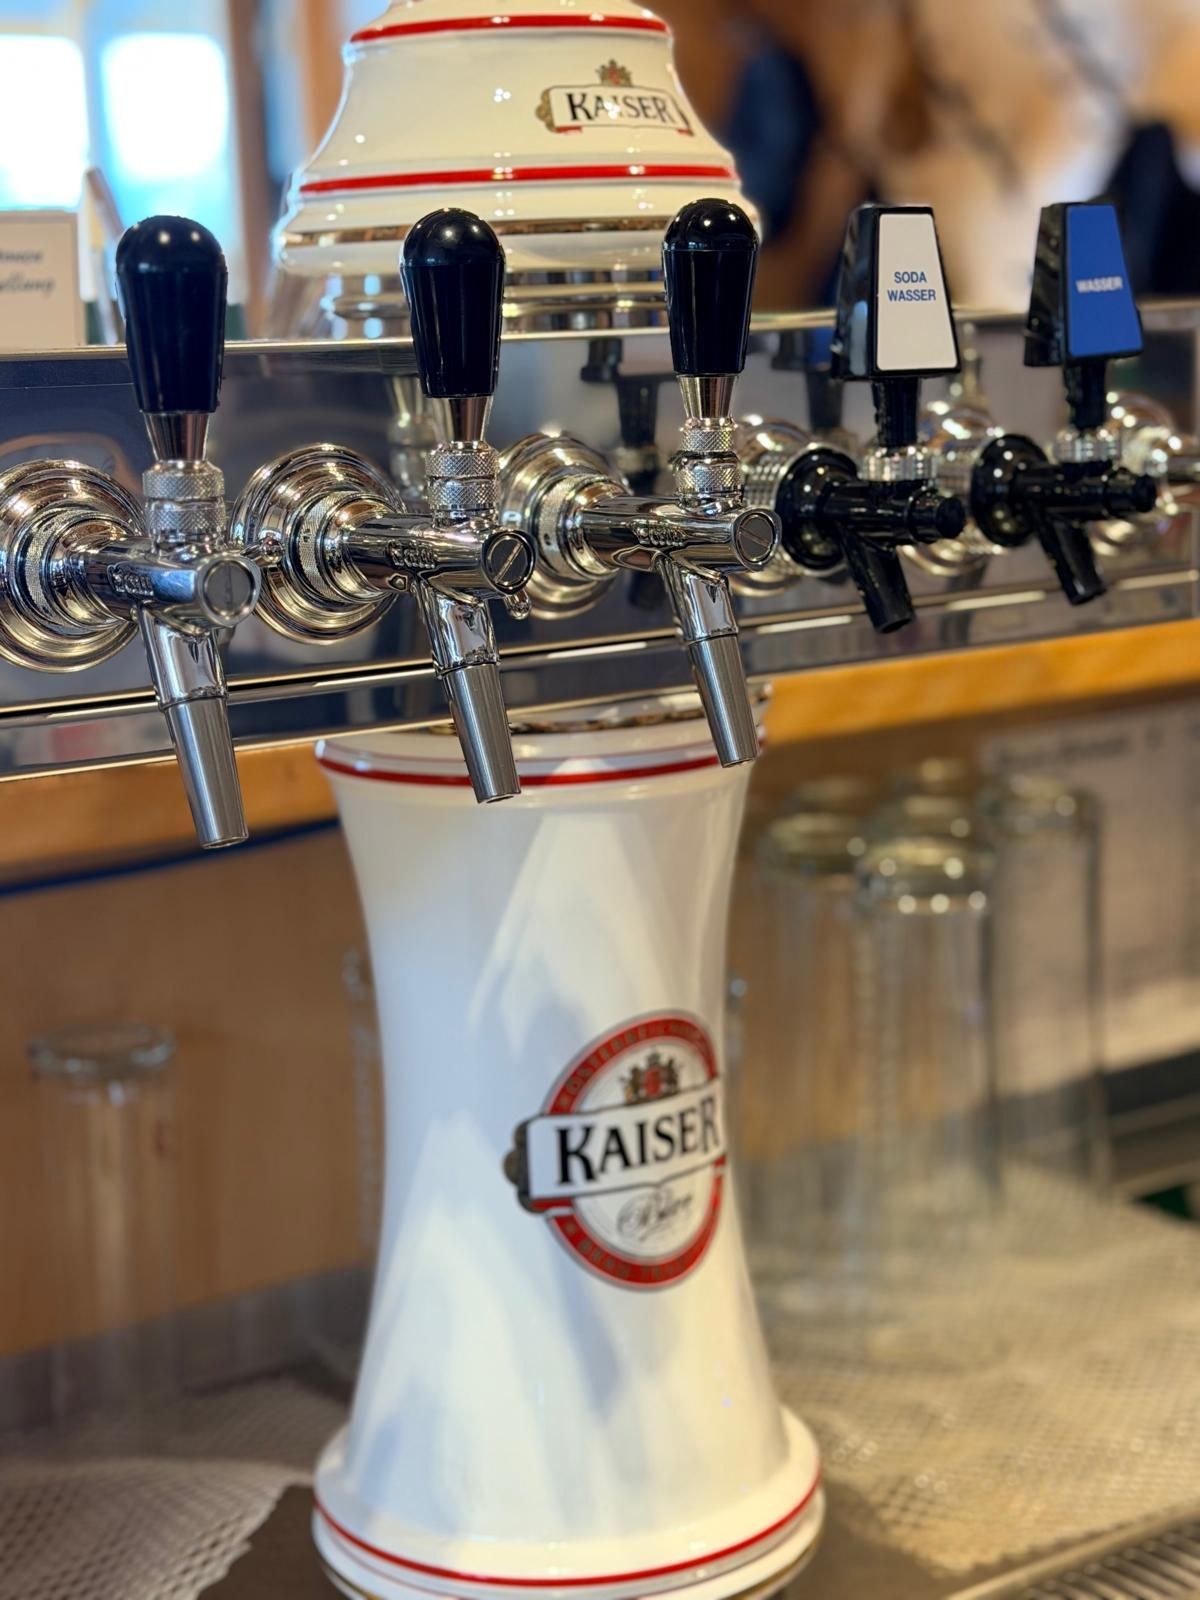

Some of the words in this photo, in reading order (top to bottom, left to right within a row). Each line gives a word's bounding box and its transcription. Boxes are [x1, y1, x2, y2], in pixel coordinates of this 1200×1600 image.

[894, 271, 927, 284] SODA
[1075, 276, 1123, 293] WASSER
[887, 288, 936, 302] WASSER
[555, 1095, 720, 1187] KAISER
